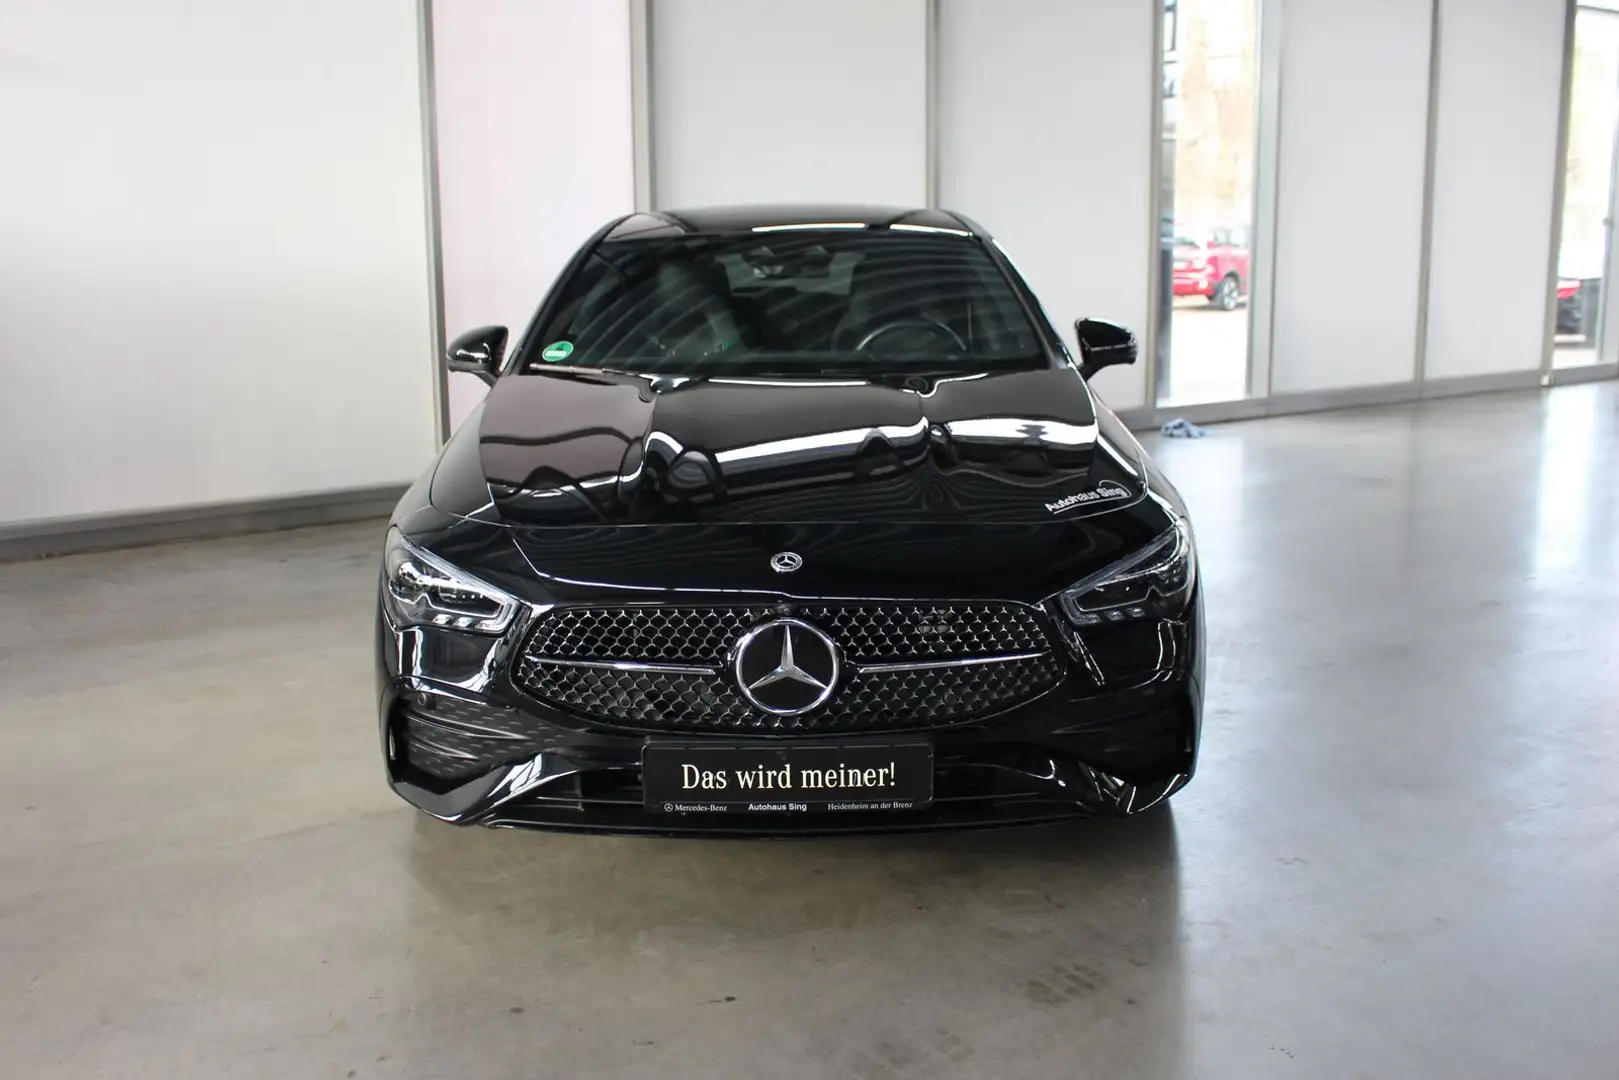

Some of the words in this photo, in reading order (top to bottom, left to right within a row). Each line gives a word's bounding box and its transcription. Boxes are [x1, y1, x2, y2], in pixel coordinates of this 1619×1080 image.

[1045, 491, 1100, 512] Autohaus
[681, 763, 727, 789] Das
[736, 763, 792, 789] wird
[801, 761, 895, 788] meiner!
[674, 803, 727, 812] Mercedes-Benz
[748, 803, 787, 811] Autohaus
[788, 802, 807, 812] Sing
[827, 803, 869, 811] Heidenheim
